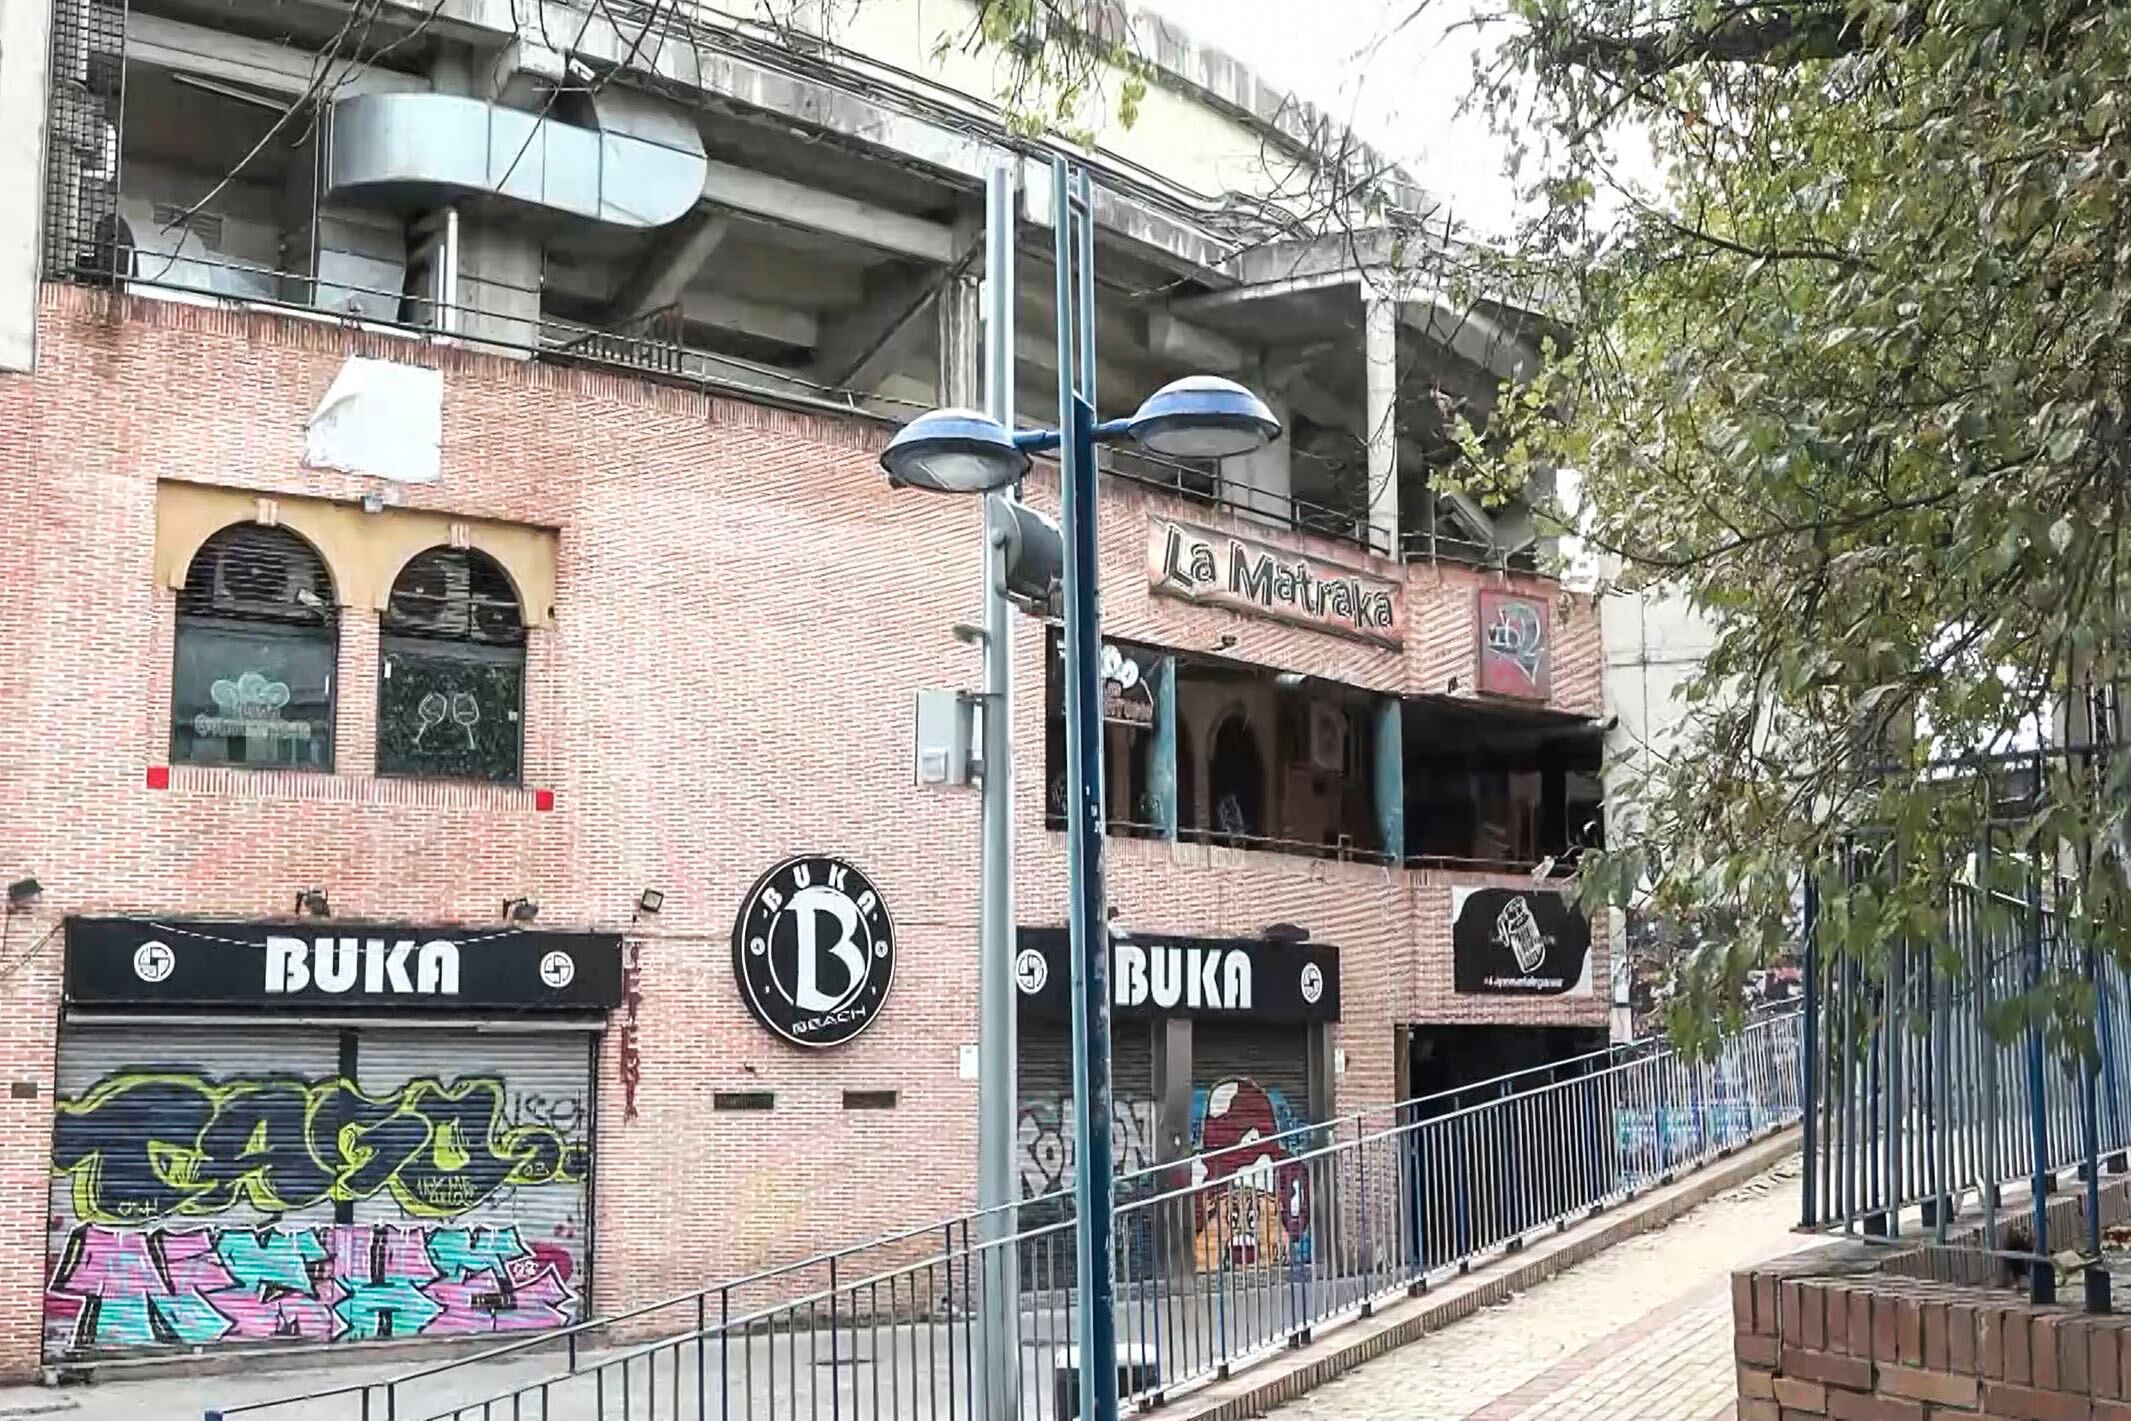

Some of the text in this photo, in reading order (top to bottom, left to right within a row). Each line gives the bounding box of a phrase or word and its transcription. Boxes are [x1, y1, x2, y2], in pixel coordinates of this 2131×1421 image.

[1162, 524, 1394, 629] La Matraka
[761, 863, 876, 915] BUKA
[265, 936, 460, 994] BUKA
[1114, 945, 1252, 1009] BUKA
[792, 1005, 866, 1034] BEACH
